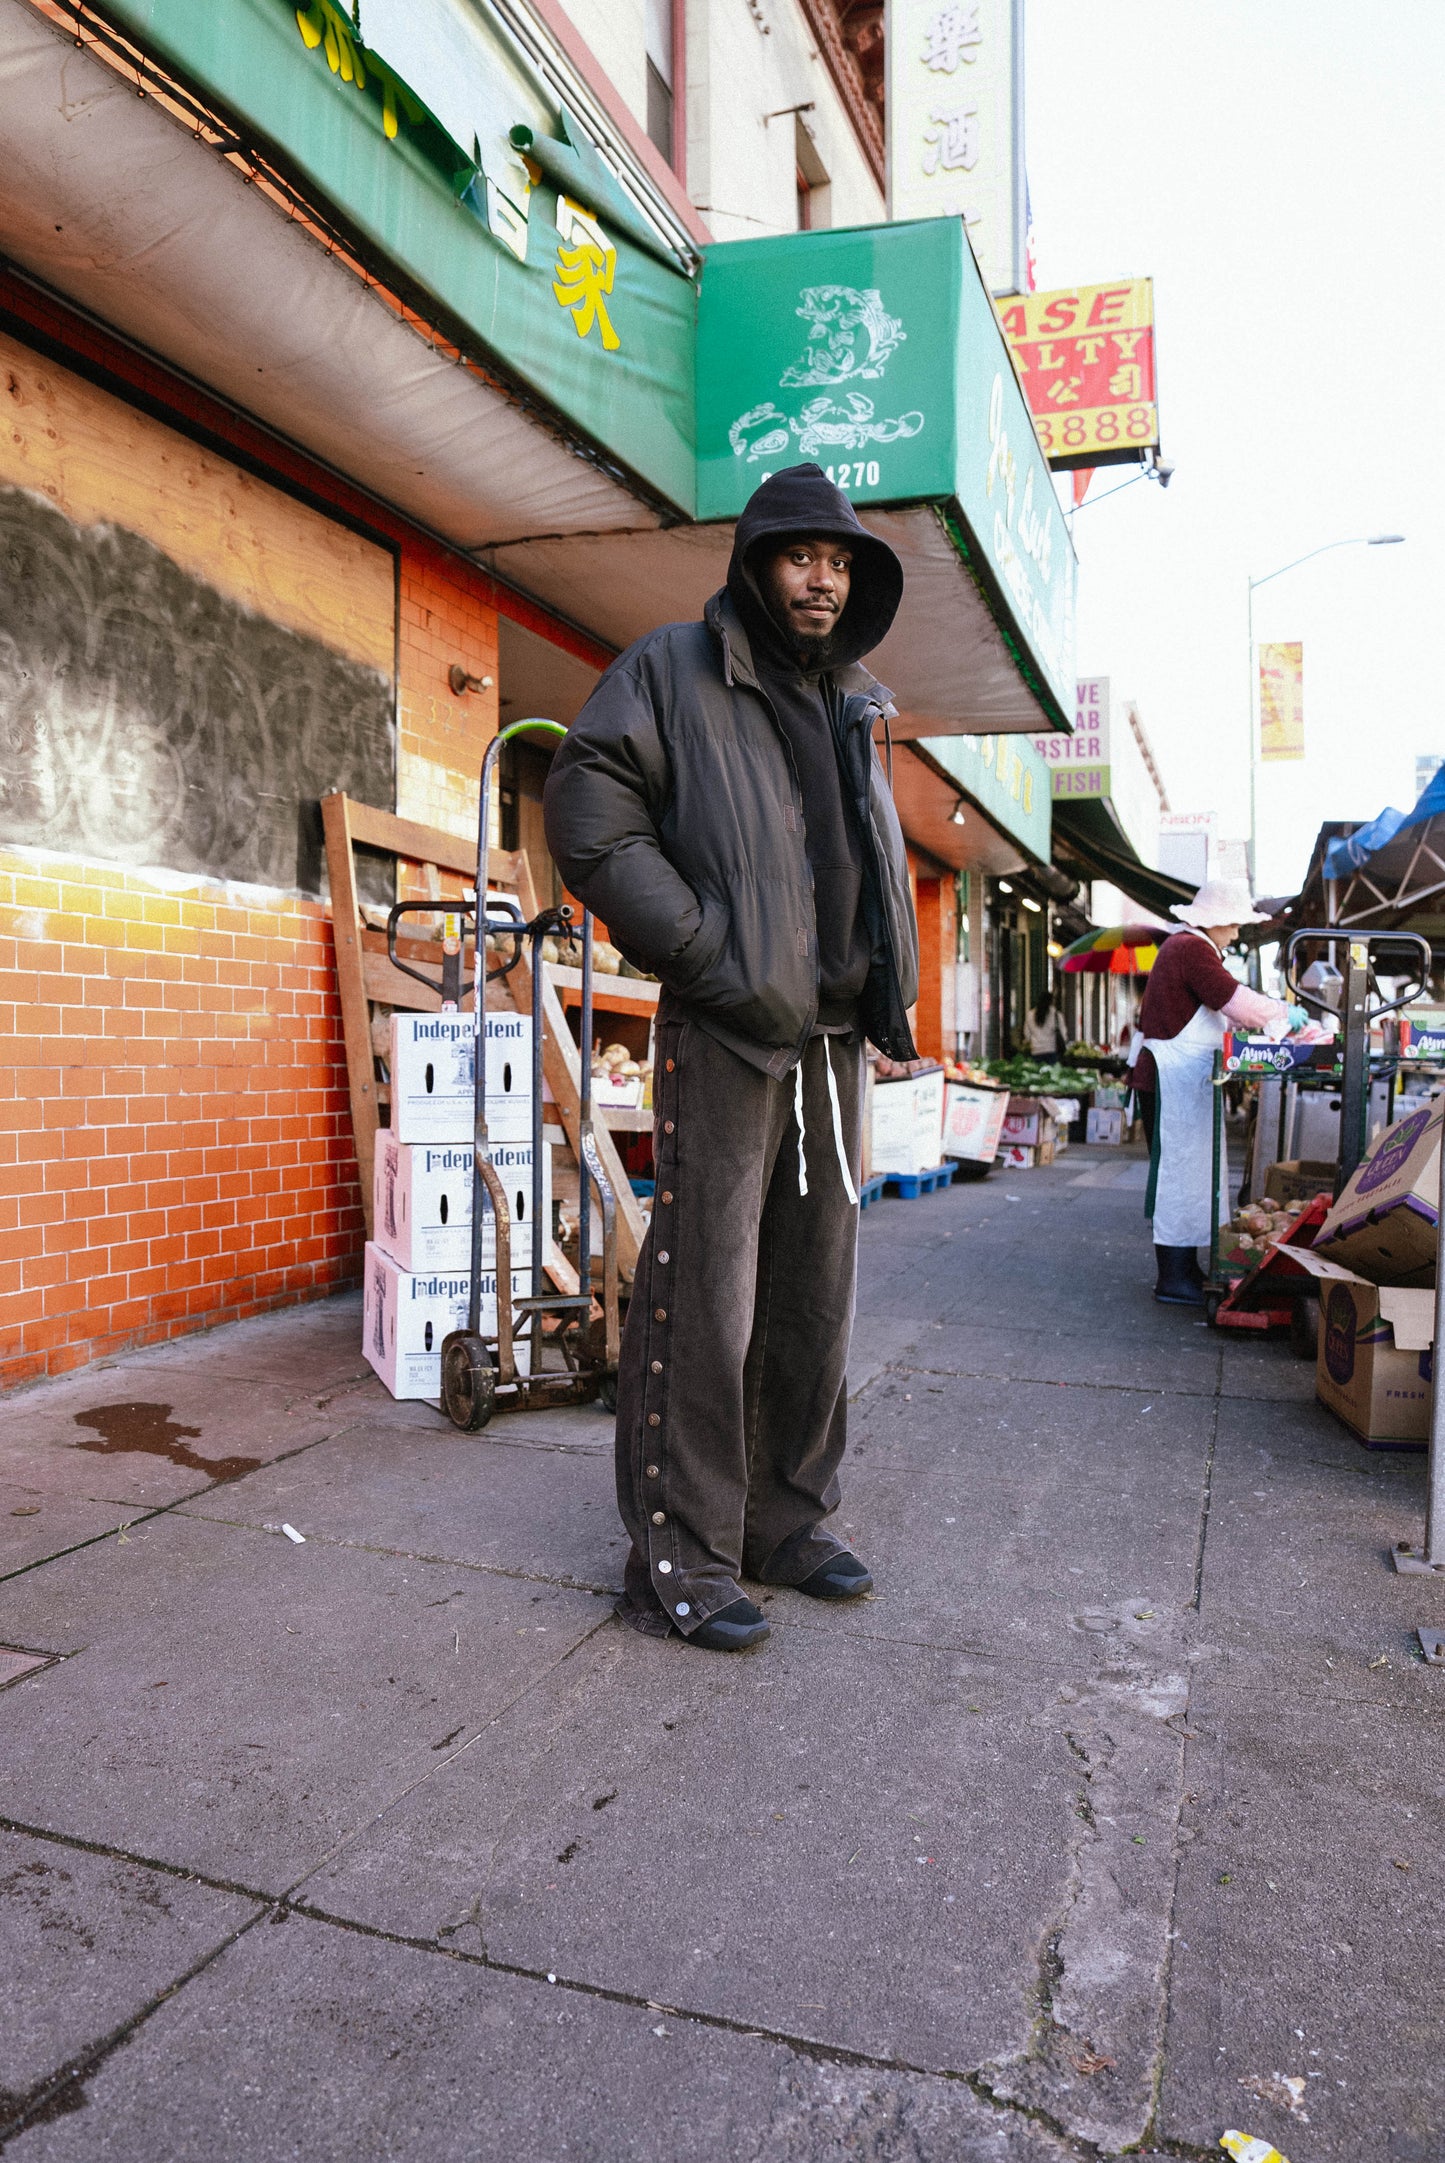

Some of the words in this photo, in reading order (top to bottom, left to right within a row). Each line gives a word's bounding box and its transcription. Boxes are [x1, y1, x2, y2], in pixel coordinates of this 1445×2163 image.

[1076, 684, 1100, 705] VE
[1054, 771, 1102, 793] FISH
[413, 1020, 524, 1041] Indepedent
